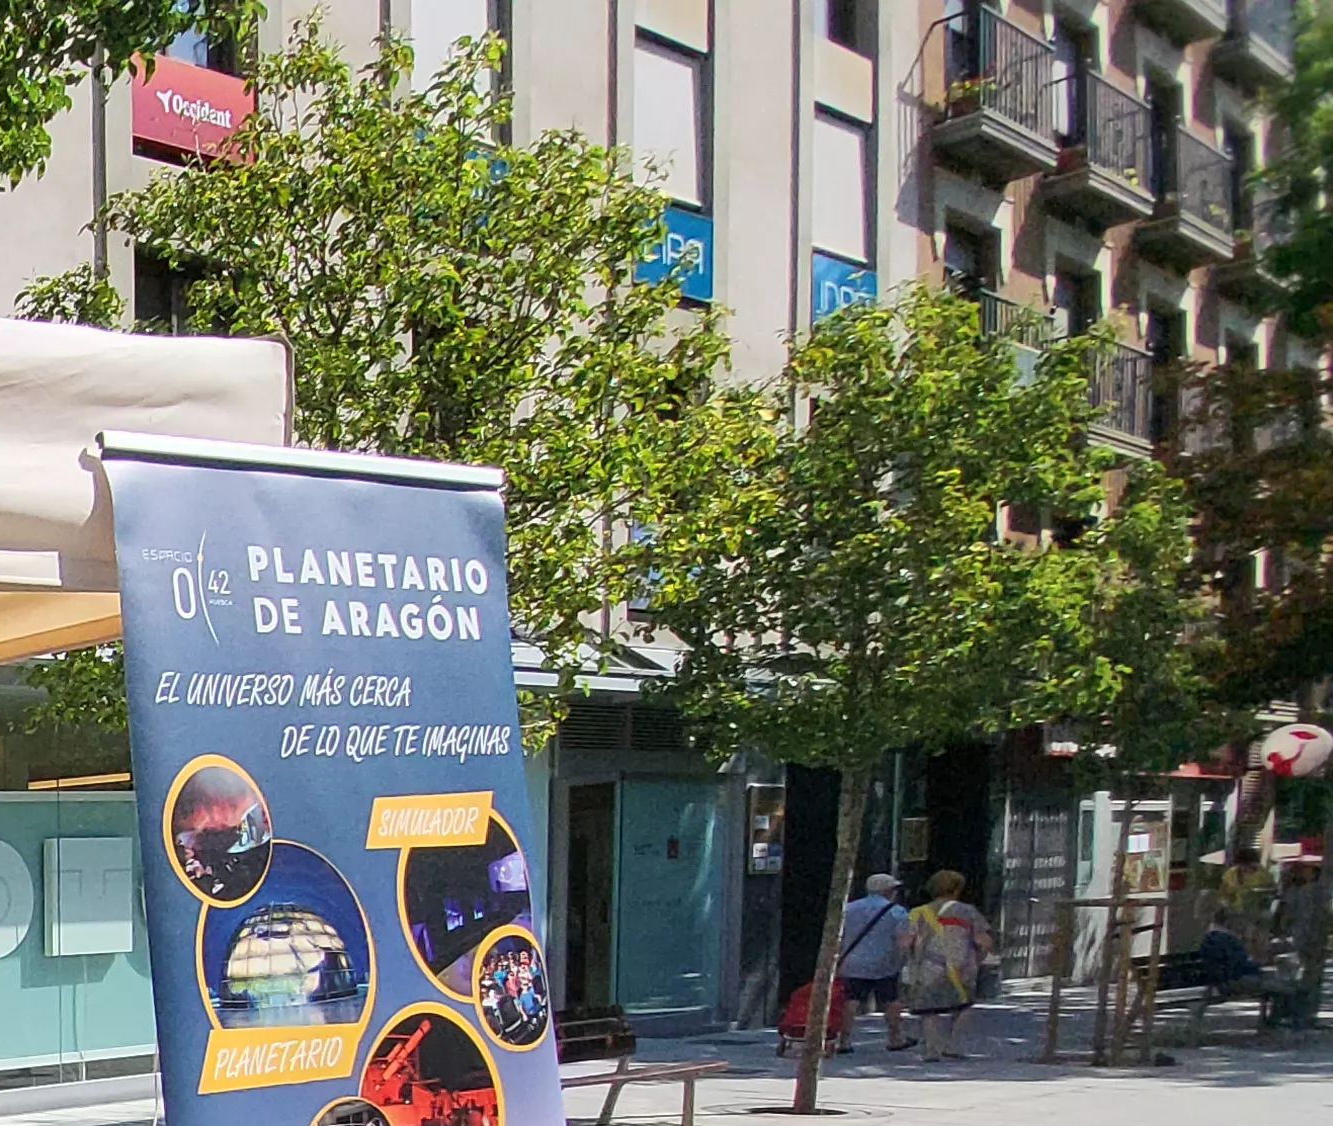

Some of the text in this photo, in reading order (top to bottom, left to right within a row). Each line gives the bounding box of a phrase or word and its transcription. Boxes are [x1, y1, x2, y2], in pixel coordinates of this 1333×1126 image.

[173, 94, 231, 128] Occident
[142, 549, 193, 563] ESPACIO
[247, 545, 488, 595] PLANETARIO
[207, 569, 232, 595] 42
[253, 594, 481, 641] DE ARAGÓN
[155, 667, 412, 708] EL UNIVERSO MÁS CERCA
[281, 724, 512, 763] DE LO QUE TE IMAGINAS
[378, 806, 481, 839] SIMULADOR
[214, 1036, 343, 1081] PLANETARIO
